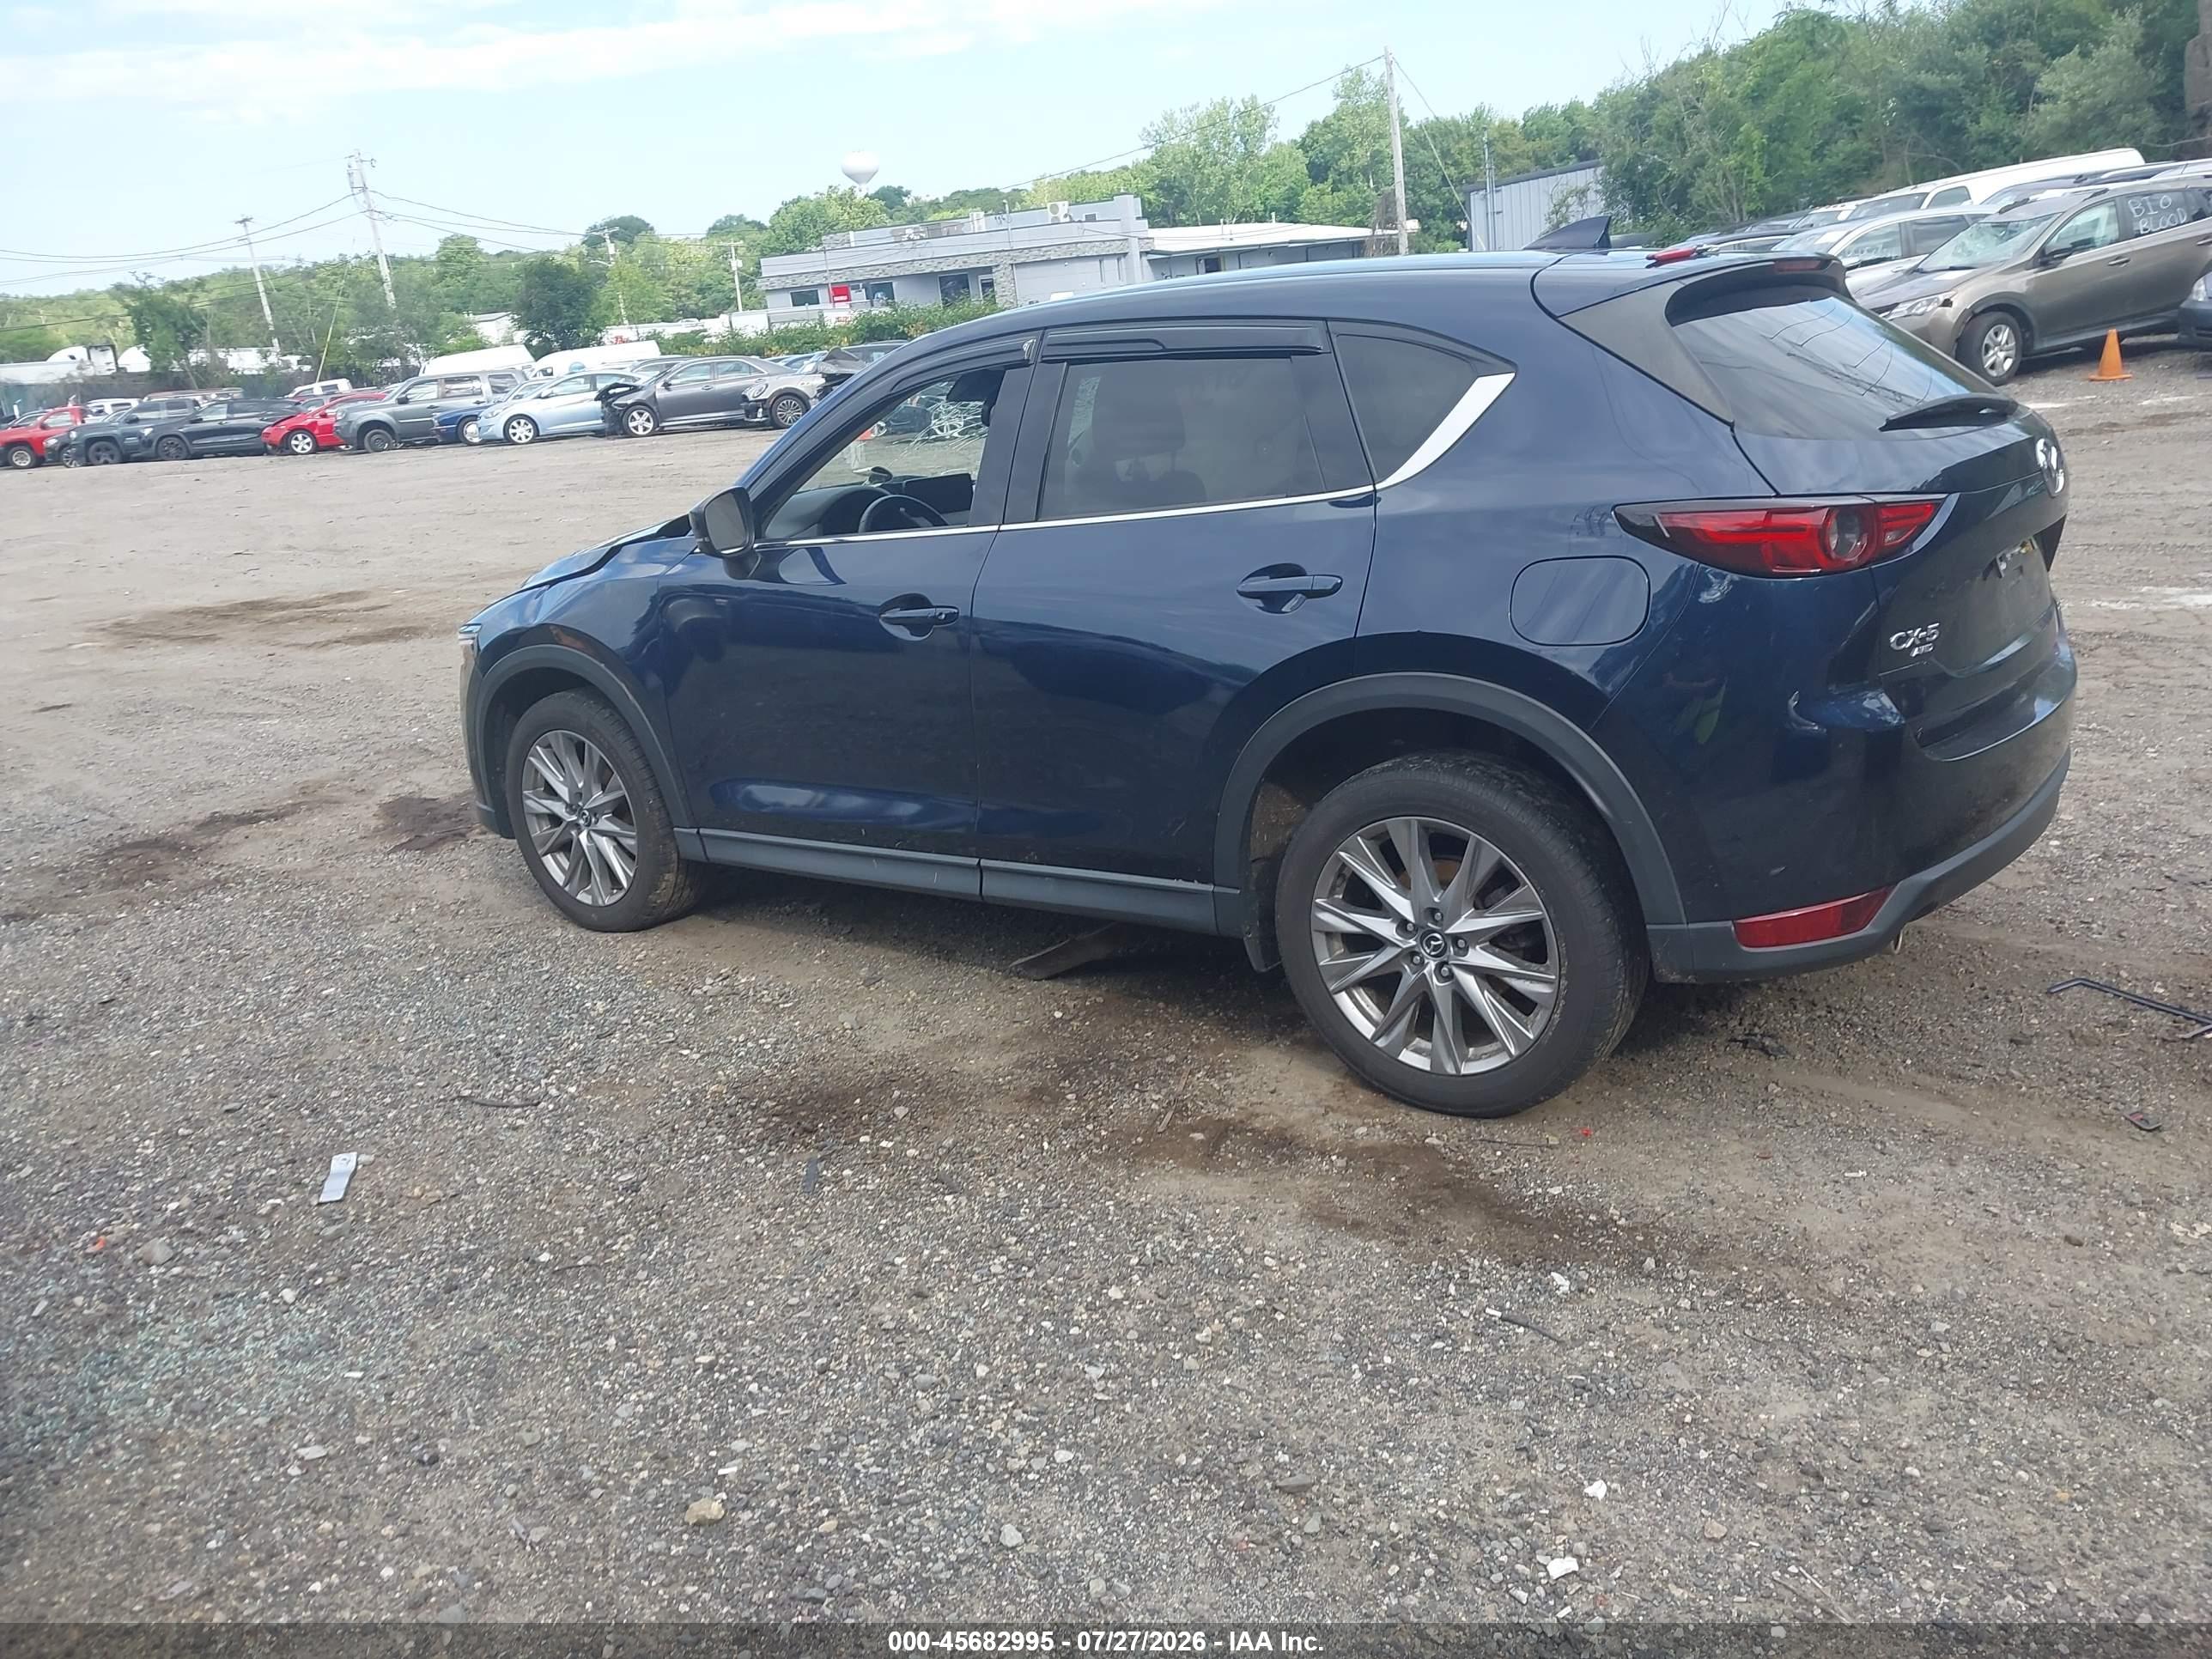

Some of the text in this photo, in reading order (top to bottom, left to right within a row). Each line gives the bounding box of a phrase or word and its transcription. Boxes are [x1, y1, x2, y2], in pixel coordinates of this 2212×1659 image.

[2128, 194, 2172, 218] BIO
[2138, 207, 2188, 235] BLOOD
[1889, 623, 1940, 651] CX-5
